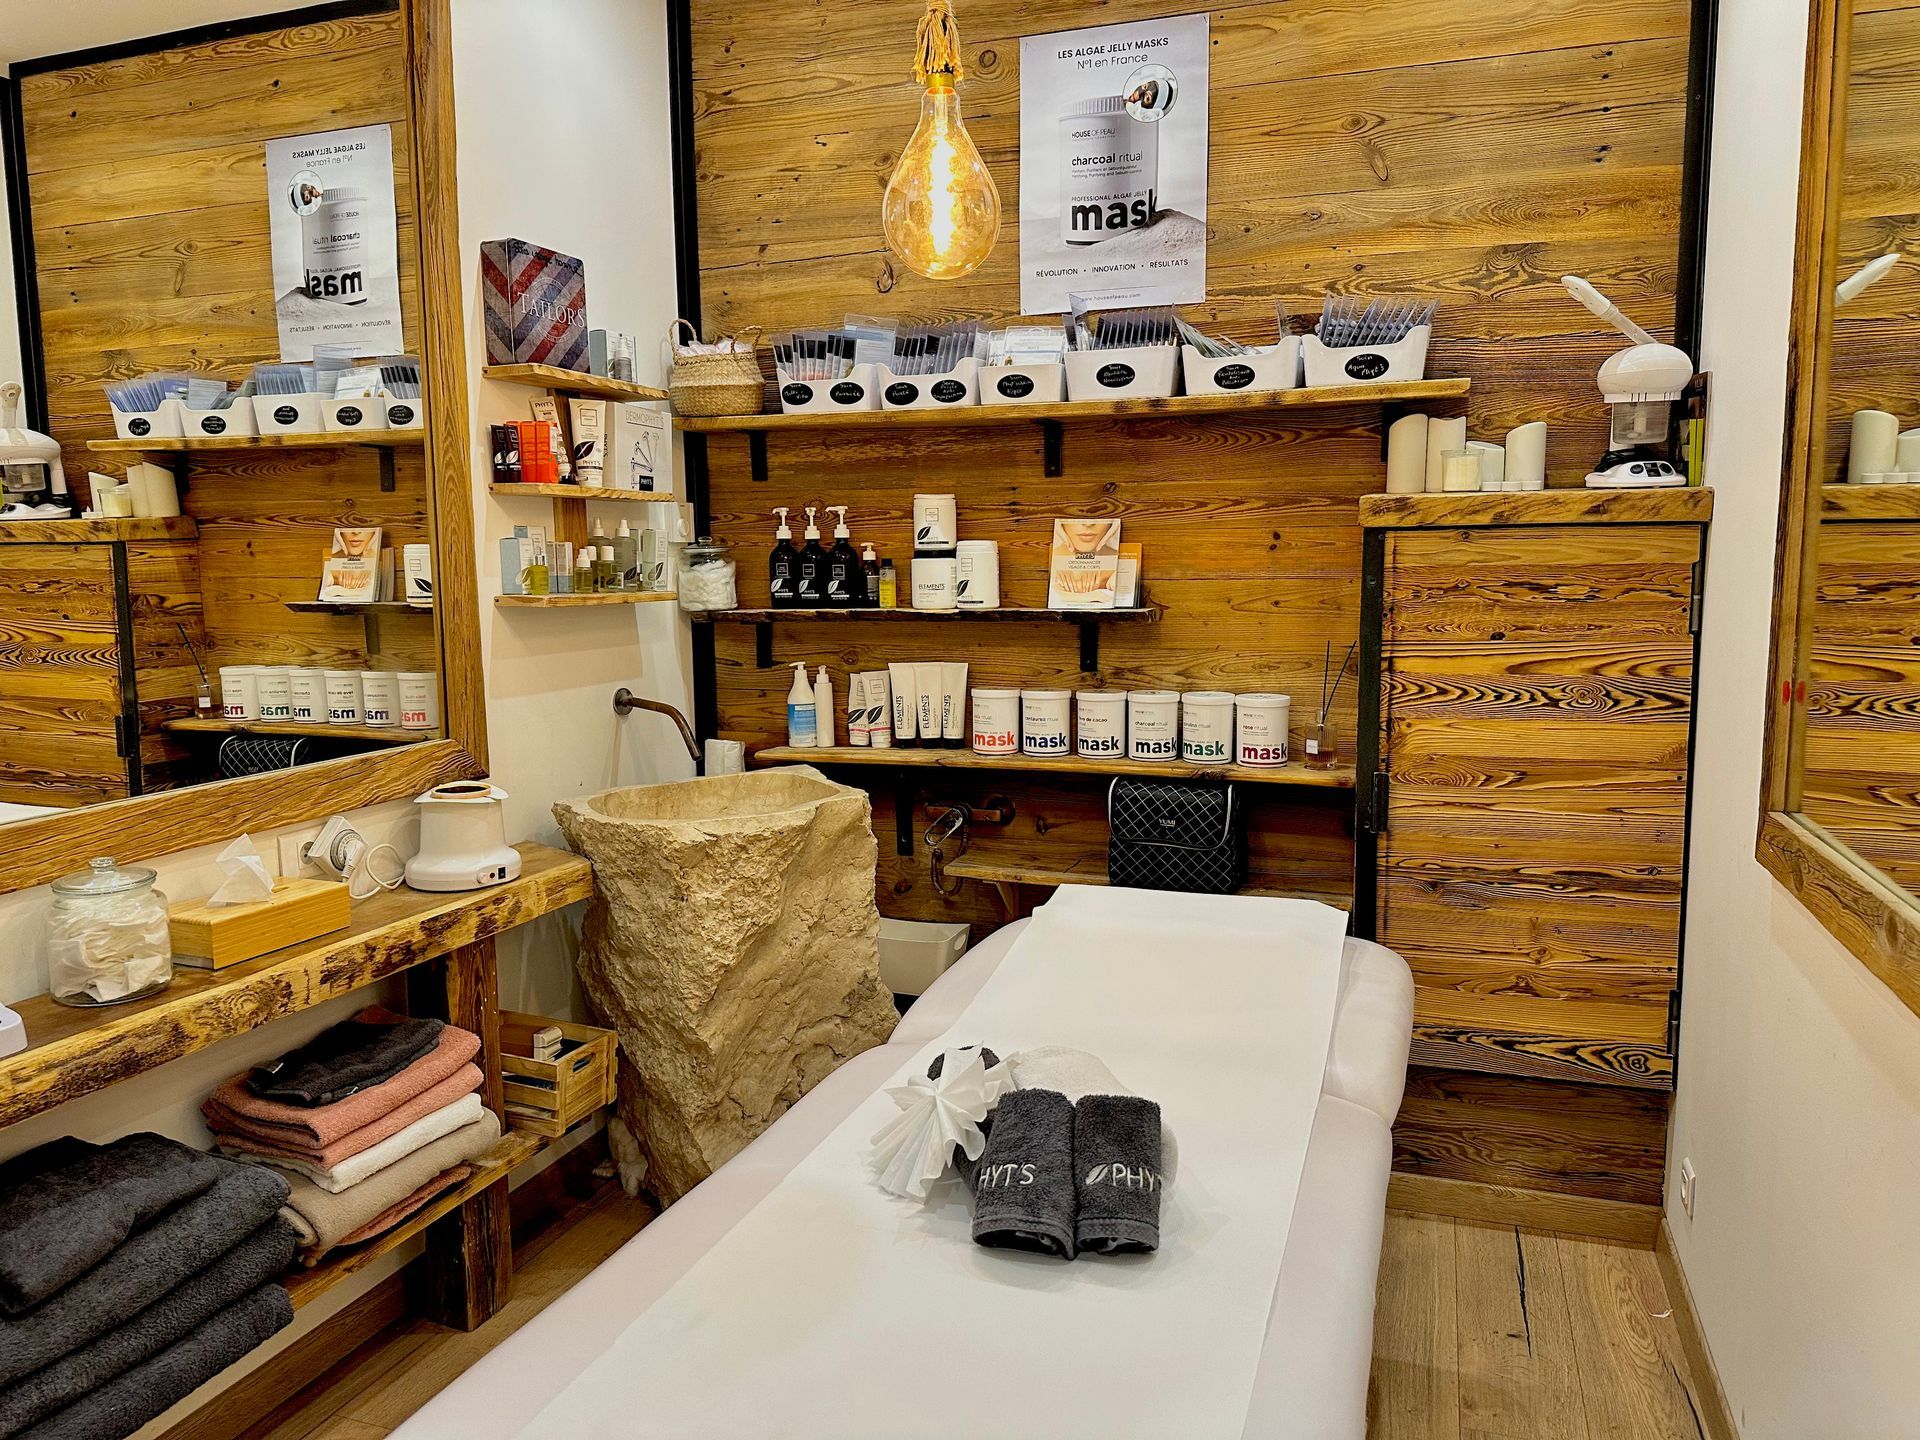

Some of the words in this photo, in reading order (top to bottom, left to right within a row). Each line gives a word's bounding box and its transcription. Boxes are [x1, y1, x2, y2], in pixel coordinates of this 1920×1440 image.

[1058, 50, 1073, 59] LES
[1075, 45, 1105, 57] ALGAE
[1107, 41, 1132, 53] JELLY
[1135, 37, 1169, 50] MASKS
[1094, 58, 1108, 68] en
[1111, 54, 1148, 66] France
[1072, 130, 1091, 138] HOUSE
[1072, 153, 1116, 166] charcoal
[1118, 150, 1143, 162] ritual
[1036, 268, 1078, 278] RÉVOLUTION
[1092, 263, 1136, 273] INNOVATION
[1150, 258, 1189, 269] RÉSULTATS
[517, 292, 586, 328] TAILOR'S
[921, 694, 930, 729] ELEMENTS
[974, 730, 1015, 746] mask
[1025, 732, 1066, 748] mask
[1079, 736, 1120, 751] mask
[1136, 737, 1177, 754] mask
[1184, 741, 1224, 756] mask
[1242, 743, 1287, 760] mask
[1158, 818, 1176, 826] YUMI
